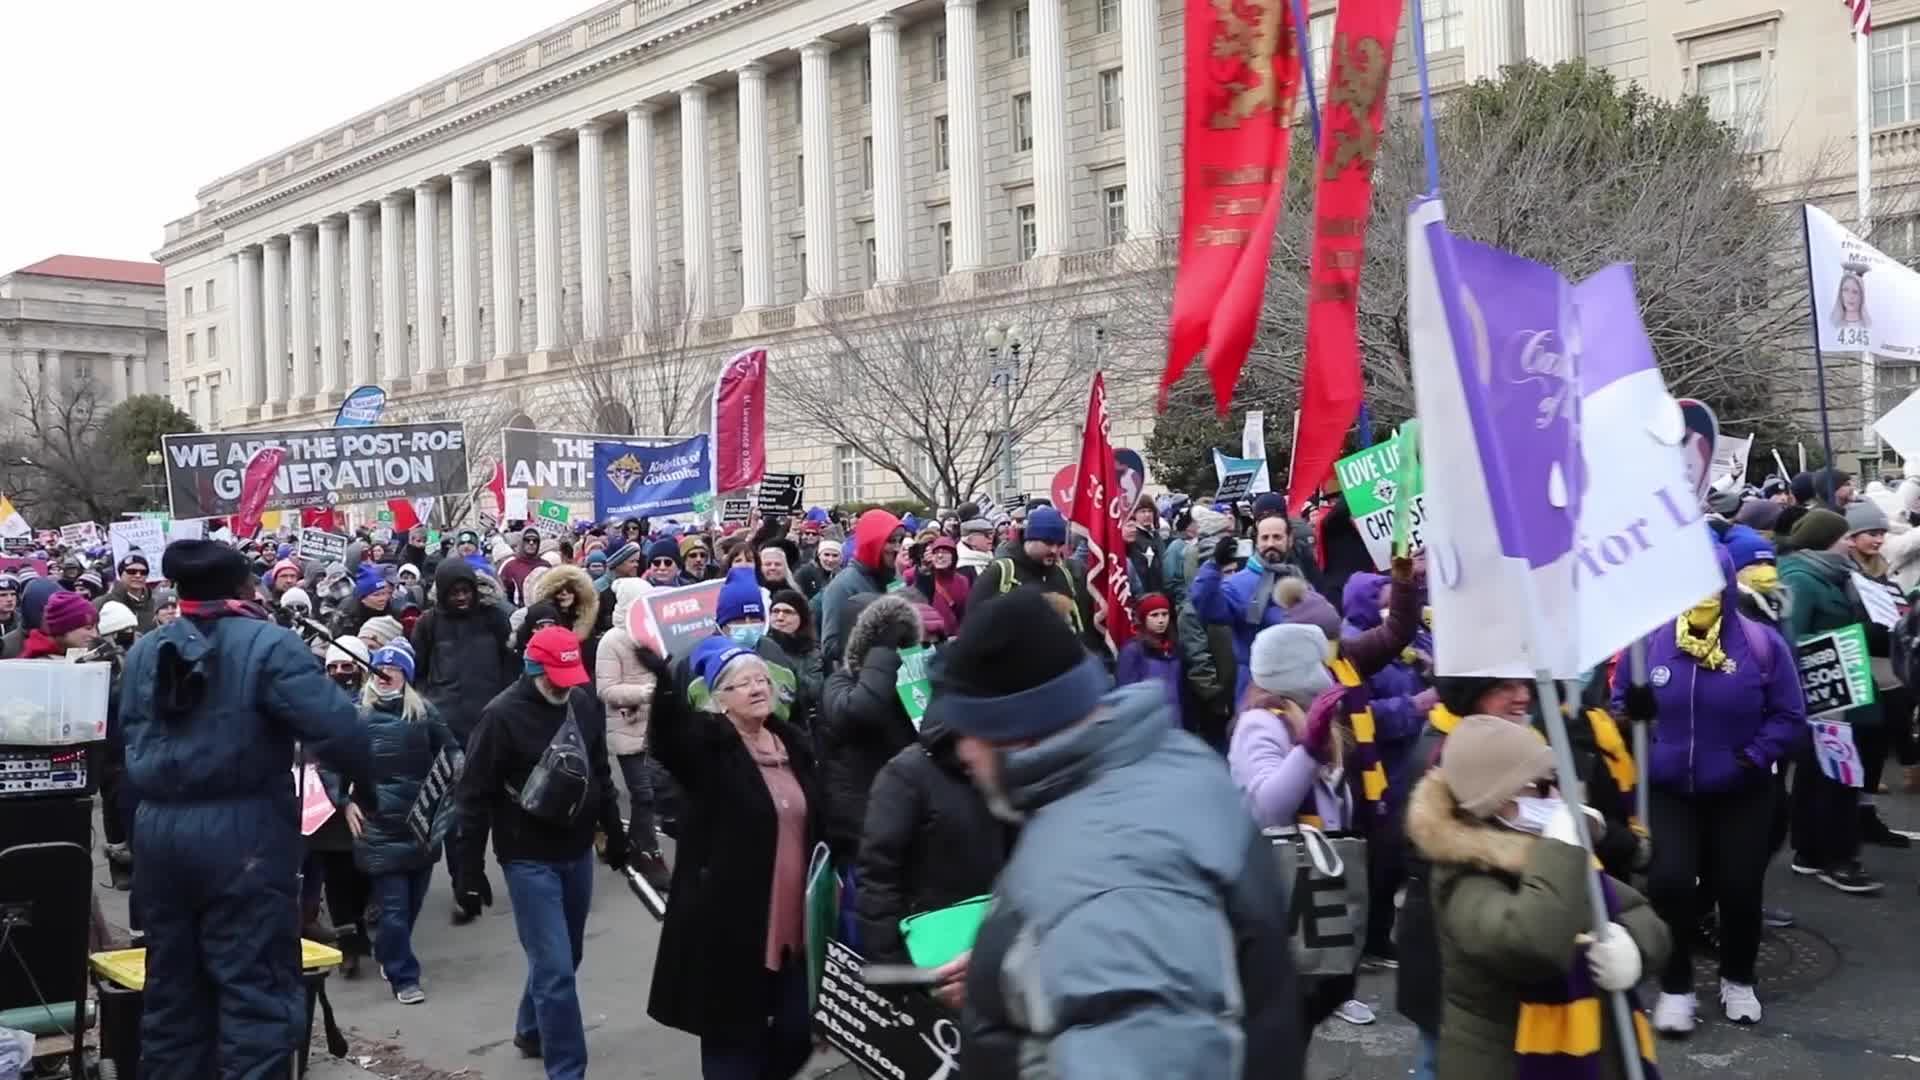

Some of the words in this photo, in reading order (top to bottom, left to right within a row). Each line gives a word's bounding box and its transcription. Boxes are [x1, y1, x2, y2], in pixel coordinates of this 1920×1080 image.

[169, 443, 219, 468] WE
[286, 436, 337, 460] THE
[342, 430, 462, 457] POST-ROE
[552, 438, 594, 458] THE
[649, 455, 688, 472] Knights
[1339, 452, 1381, 490] LOVE
[1377, 444, 1401, 475] LIF
[213, 455, 434, 500] GNERATION
[643, 467, 700, 486] Columbus
[662, 598, 701, 618] AFTER
[824, 960, 915, 1026] Deserve
[818, 993, 867, 1033] than
[814, 1009, 906, 1080] Abortion
